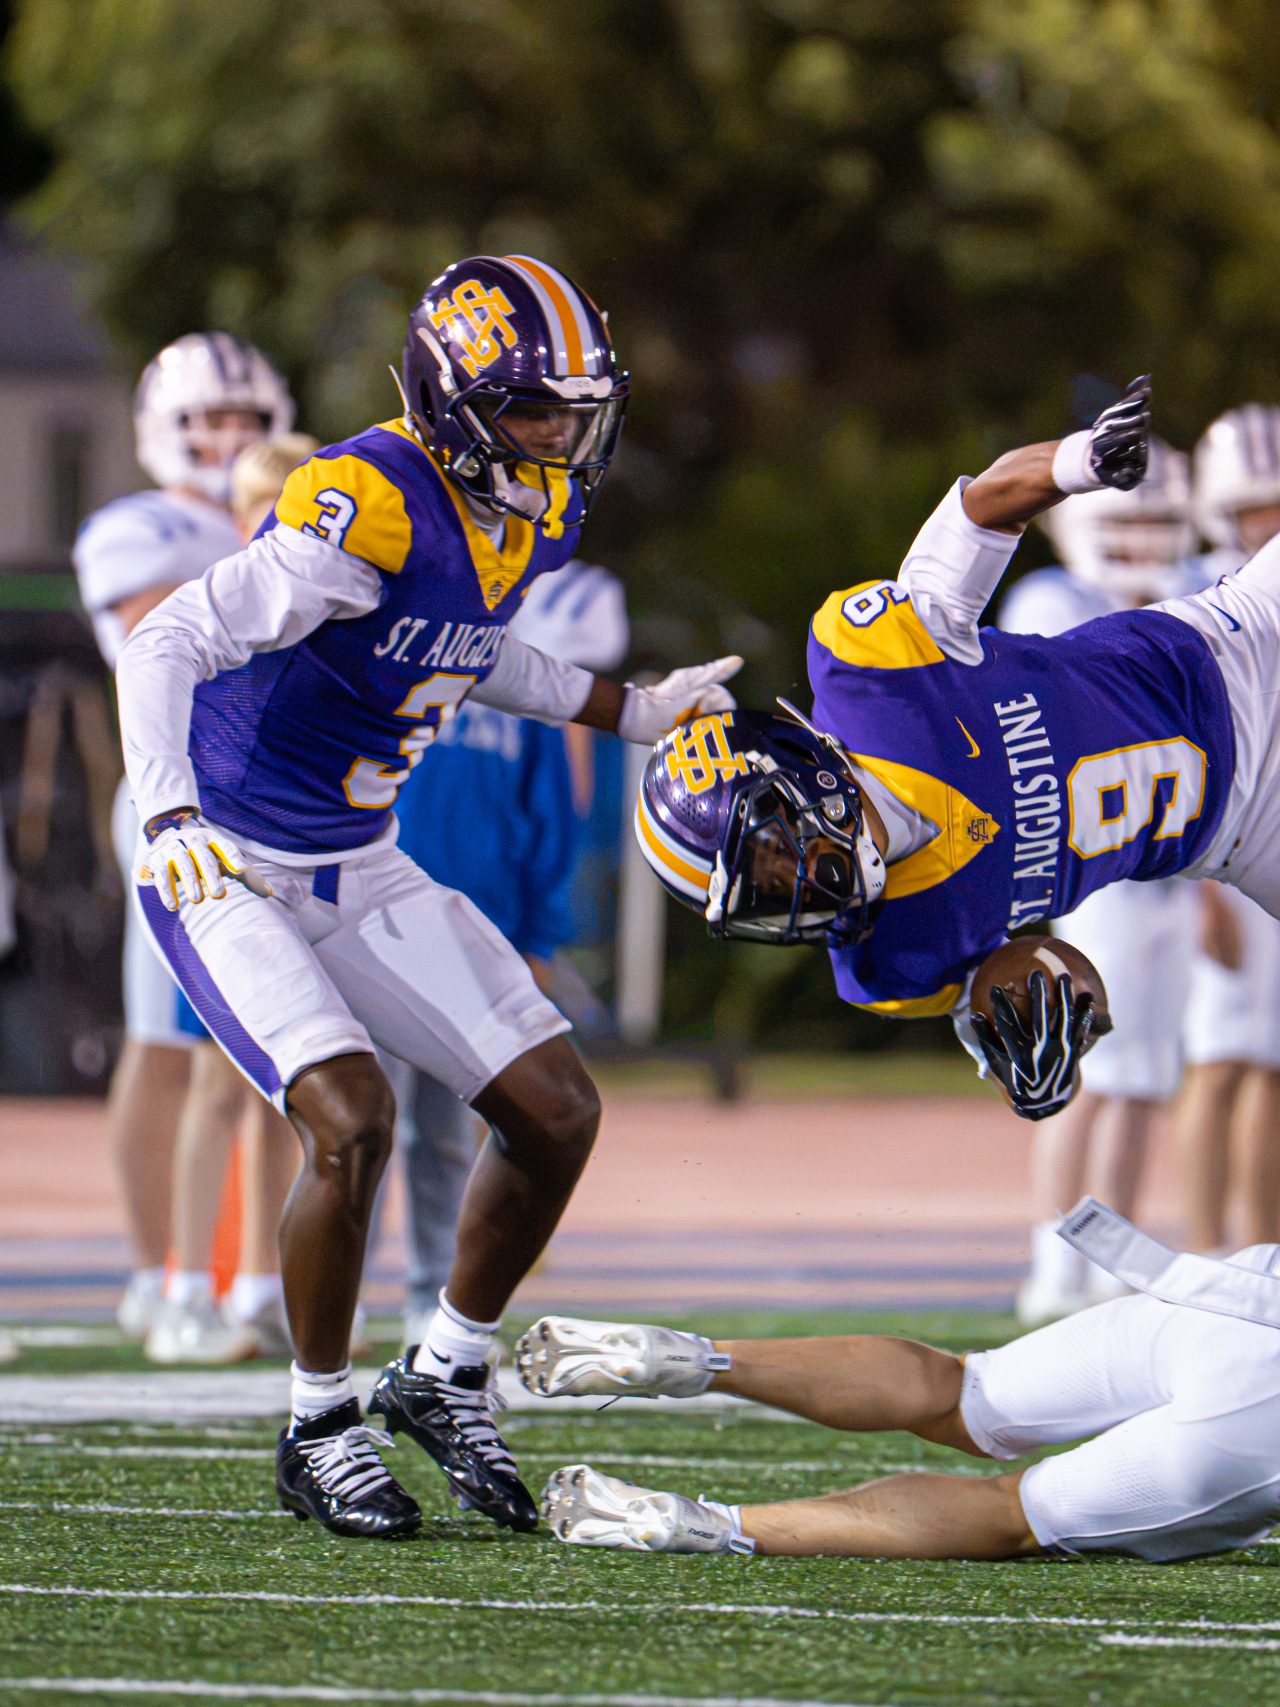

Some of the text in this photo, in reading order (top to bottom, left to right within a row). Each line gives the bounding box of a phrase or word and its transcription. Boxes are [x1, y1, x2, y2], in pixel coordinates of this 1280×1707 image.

[301, 486, 358, 550] 3
[373, 616, 429, 663] ST.
[840, 579, 911, 628] 9
[342, 671, 477, 810] 3
[993, 692, 1062, 880] AUGUSTINE
[1066, 735, 1207, 860] 9
